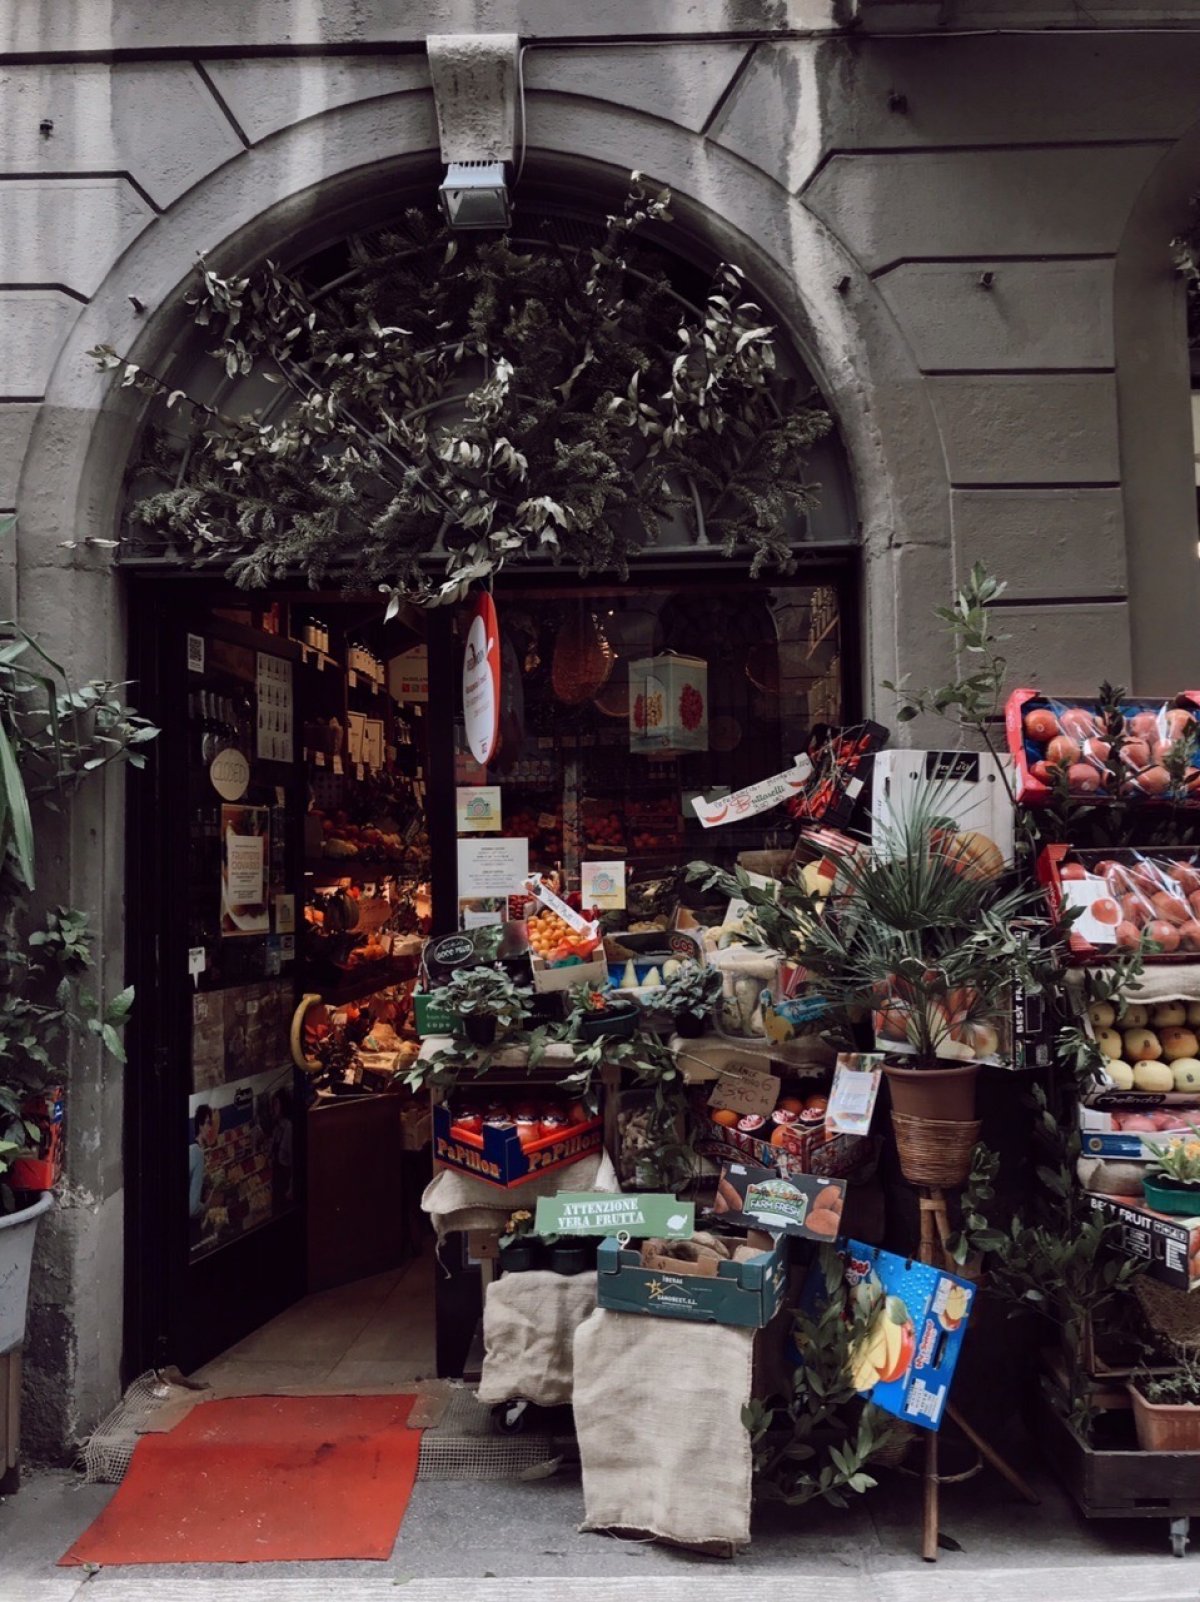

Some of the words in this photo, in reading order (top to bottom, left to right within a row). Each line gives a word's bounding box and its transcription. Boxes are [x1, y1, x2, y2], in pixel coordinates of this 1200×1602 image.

[1015, 1004, 1024, 1033] BEST
[563, 1198, 639, 1216] ATTENZIONE
[751, 1199, 773, 1210] FARM
[774, 1202, 801, 1216] FRESH
[1090, 1198, 1117, 1216] BET
[1119, 1208, 1152, 1229] FRUIT
[558, 1215, 591, 1229] VERA
[596, 1211, 645, 1226] FRUTTA
